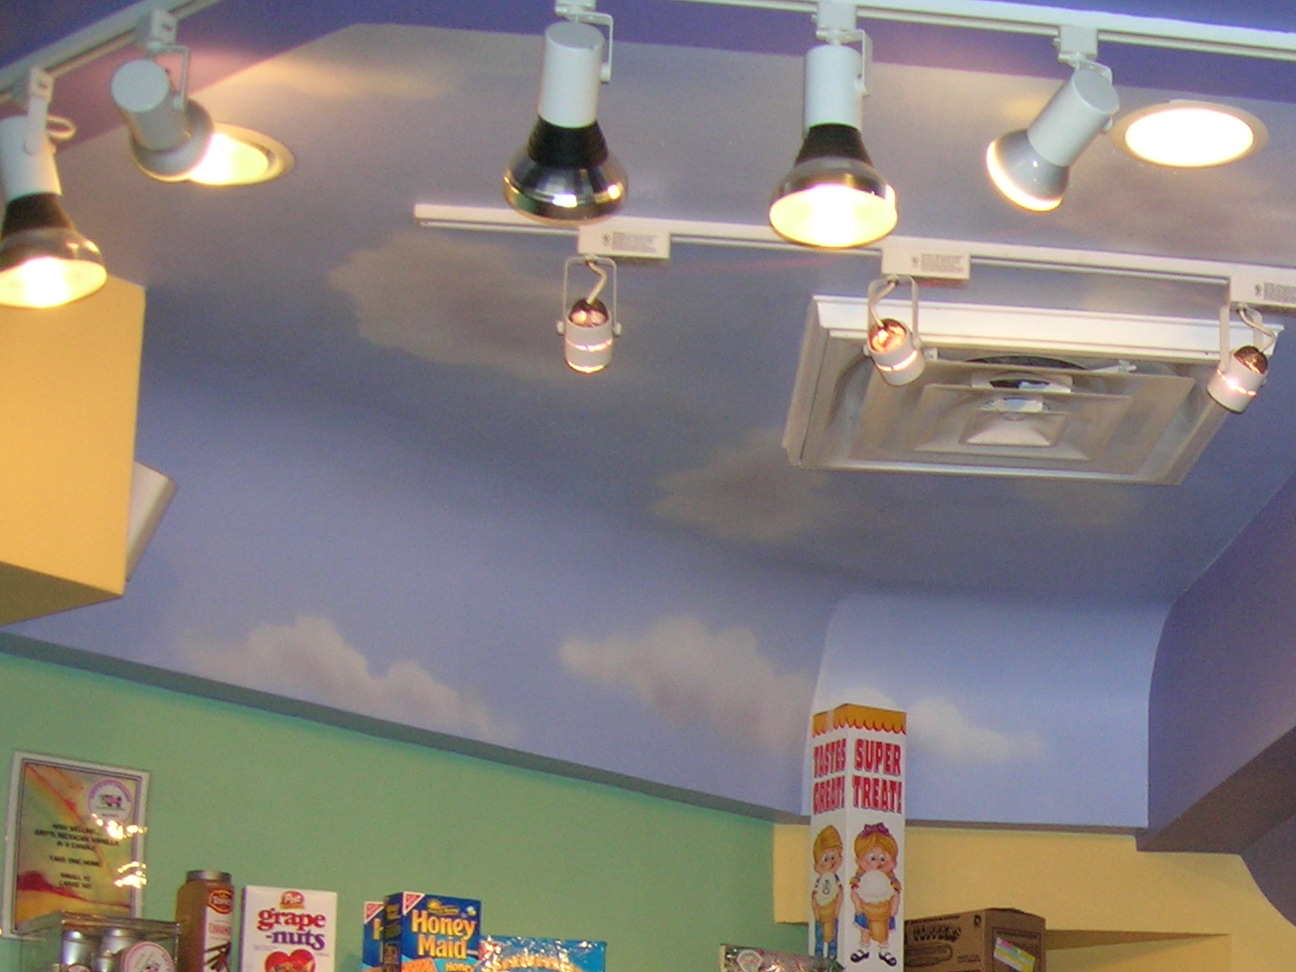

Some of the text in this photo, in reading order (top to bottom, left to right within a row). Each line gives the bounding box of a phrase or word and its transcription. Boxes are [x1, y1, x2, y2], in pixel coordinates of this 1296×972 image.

[855, 738, 901, 776] SUPER
[852, 775, 902, 814] TREAT!
[257, 907, 326, 932] grape
[411, 908, 477, 941] Honey
[265, 930, 325, 951] -nuts
[418, 934, 467, 959] Maid
